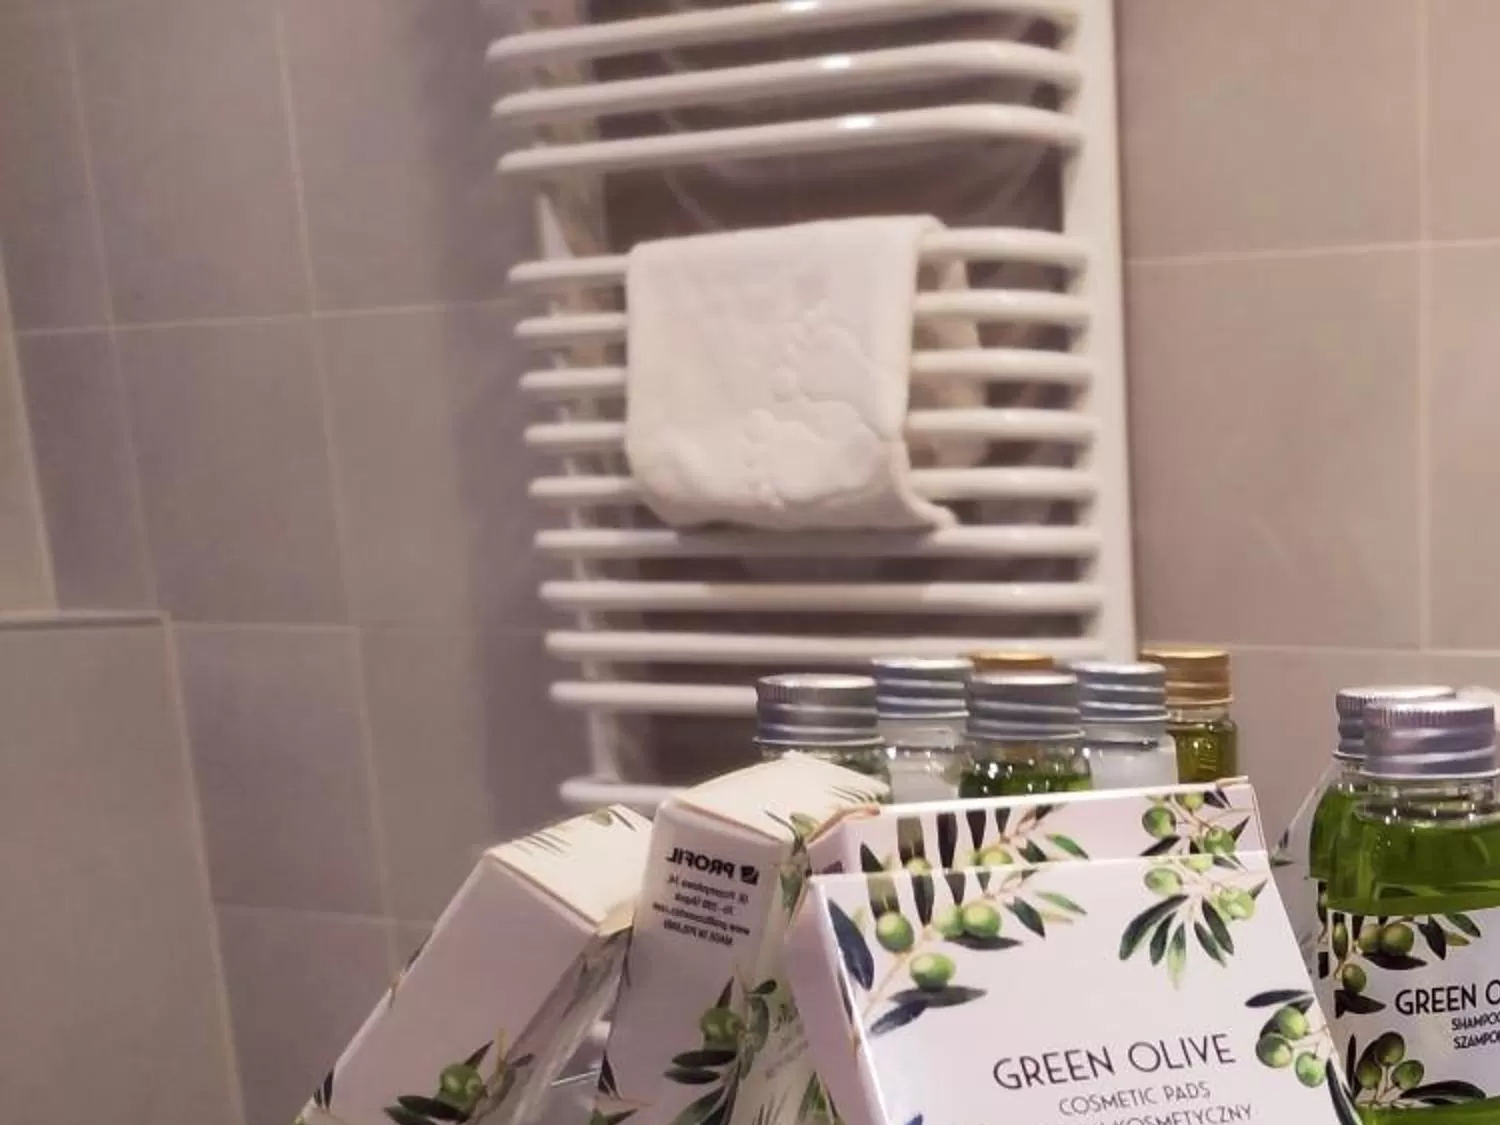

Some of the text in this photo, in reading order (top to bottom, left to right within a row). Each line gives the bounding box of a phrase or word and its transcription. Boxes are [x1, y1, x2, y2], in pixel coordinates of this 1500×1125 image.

[1395, 983, 1477, 1015] GREEN
[993, 1033, 1237, 1090] GREEN OLIVE
[1058, 1081, 1211, 1116] COSMETIC PADS
